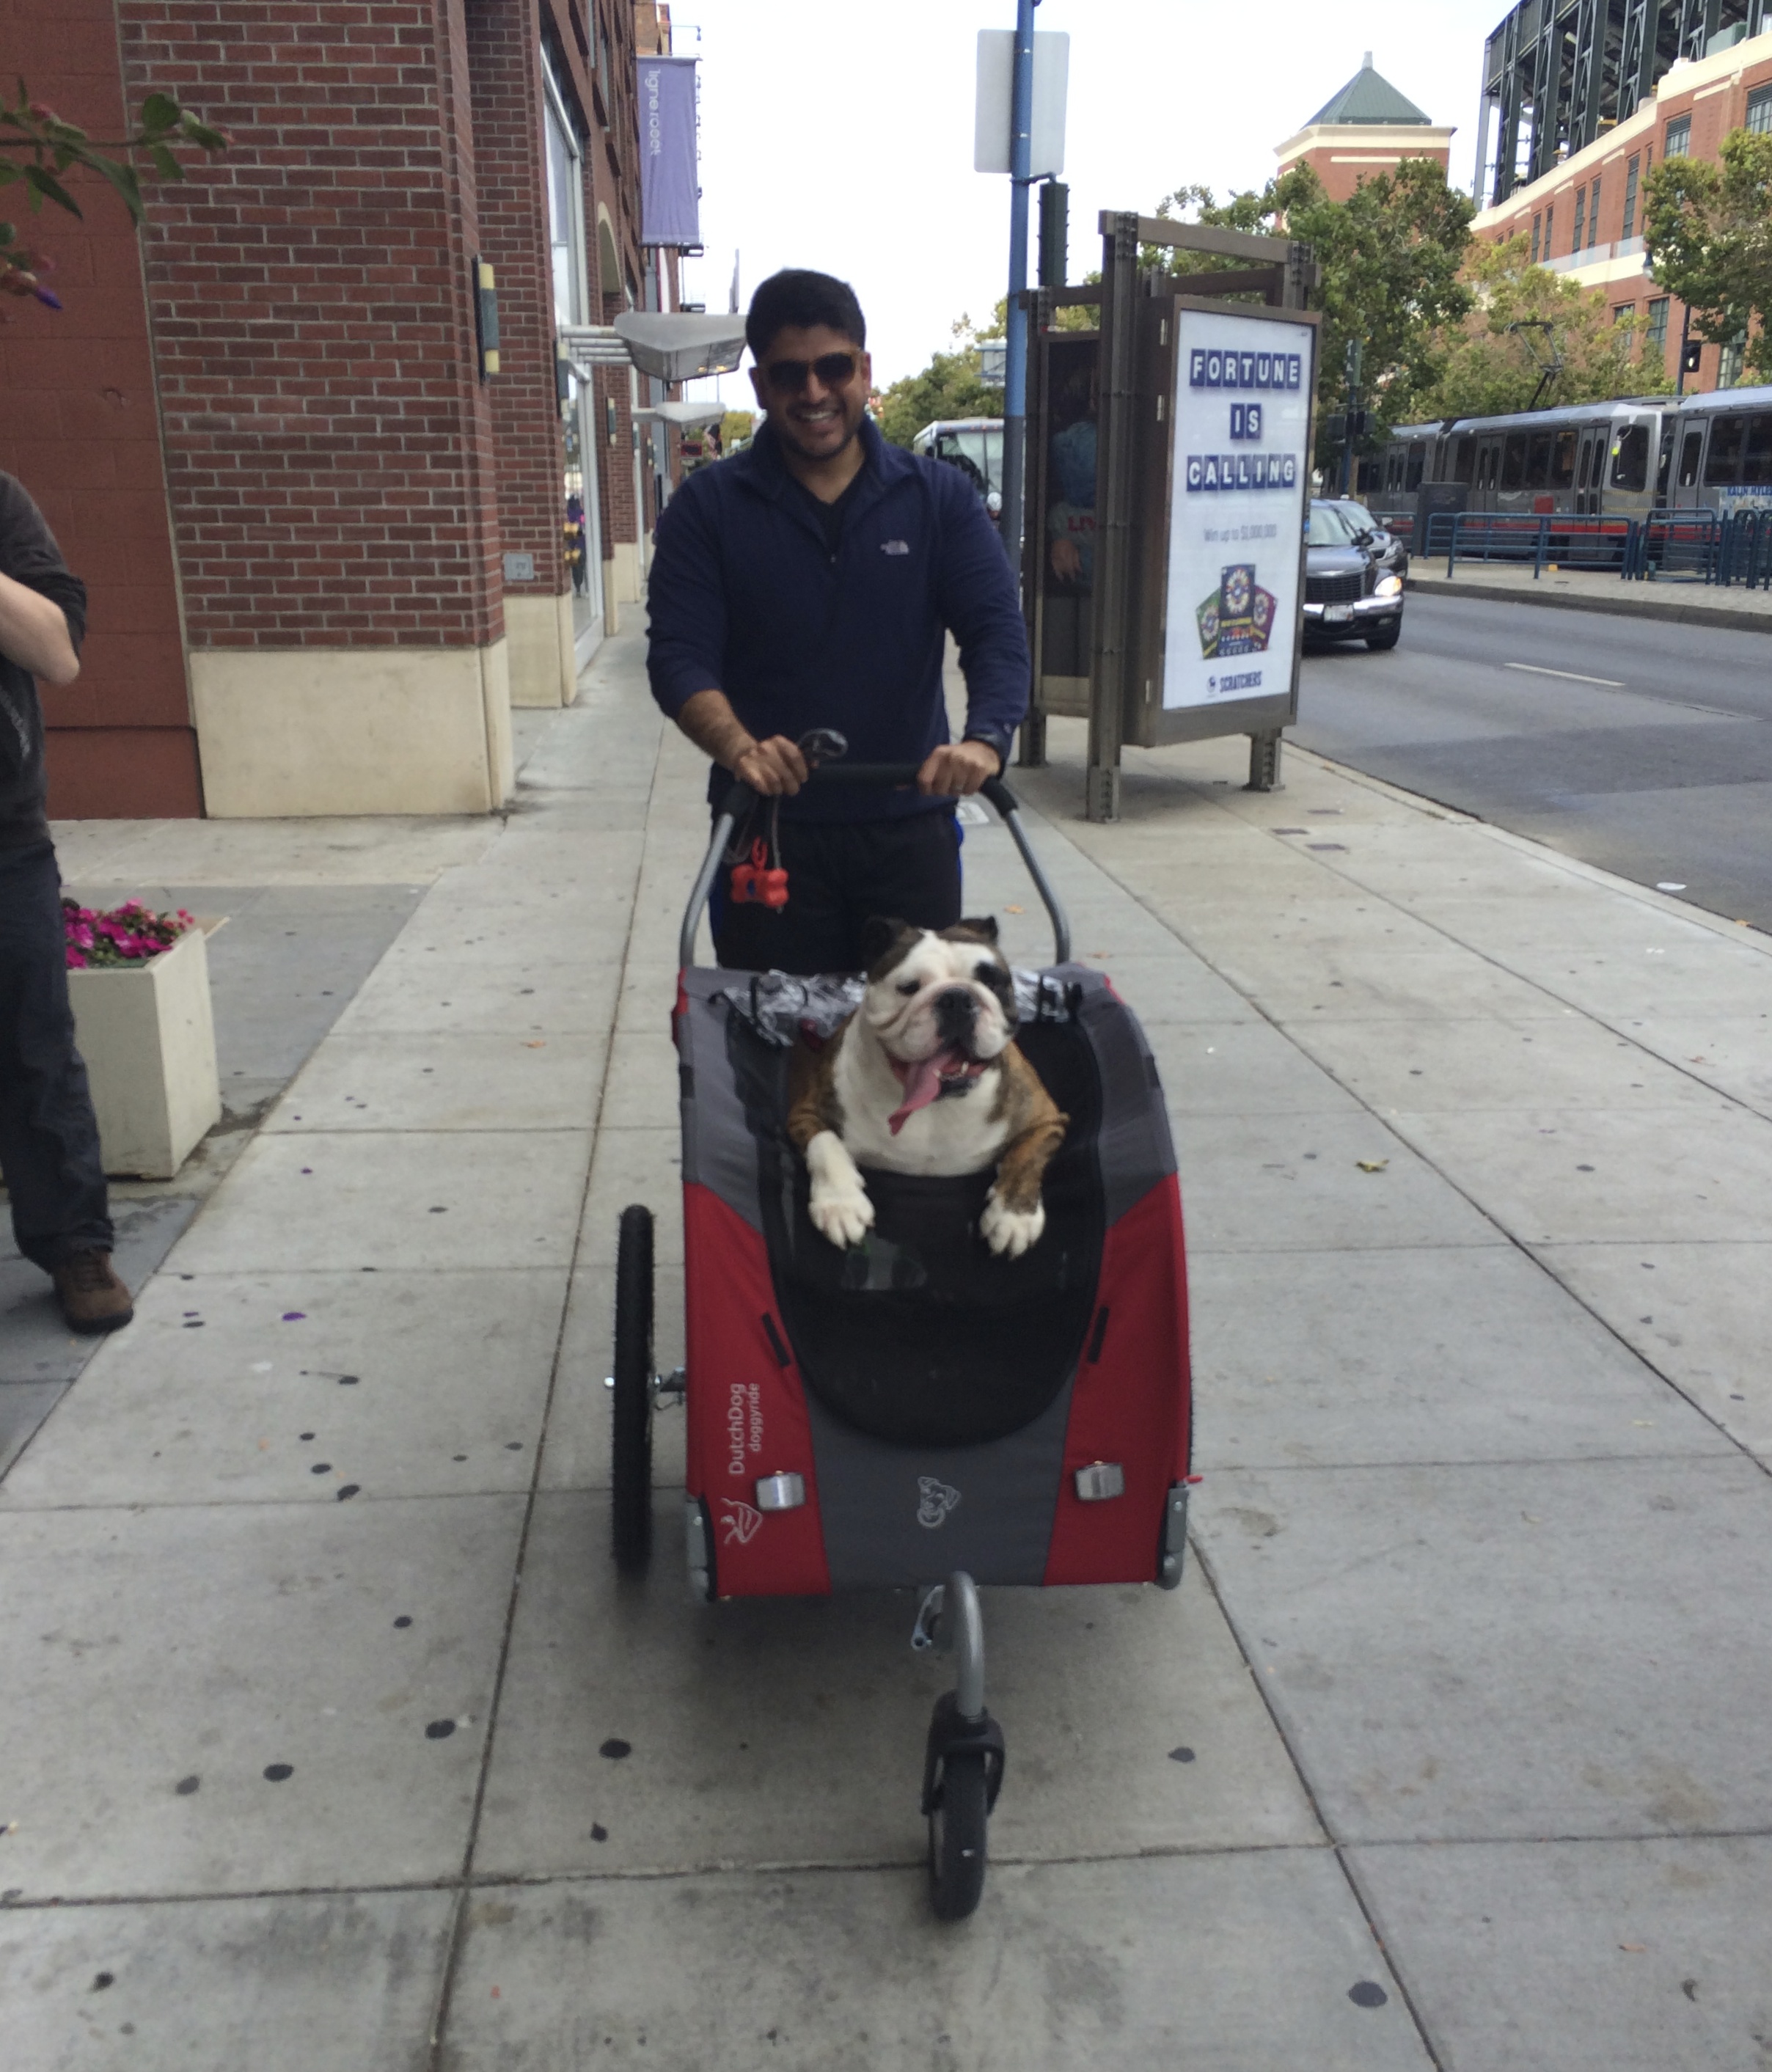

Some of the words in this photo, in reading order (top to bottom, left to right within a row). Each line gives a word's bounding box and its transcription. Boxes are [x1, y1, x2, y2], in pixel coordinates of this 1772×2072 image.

[645, 69, 660, 111] ligne
[1191, 355, 1300, 384] FORTUNE
[1234, 409, 1260, 433] IS
[1187, 458, 1295, 486] CALLING
[1219, 670, 1262, 693] SCRATCHERS
[727, 1383, 746, 1475] DutchDog
[747, 1383, 764, 1453] doggyride
